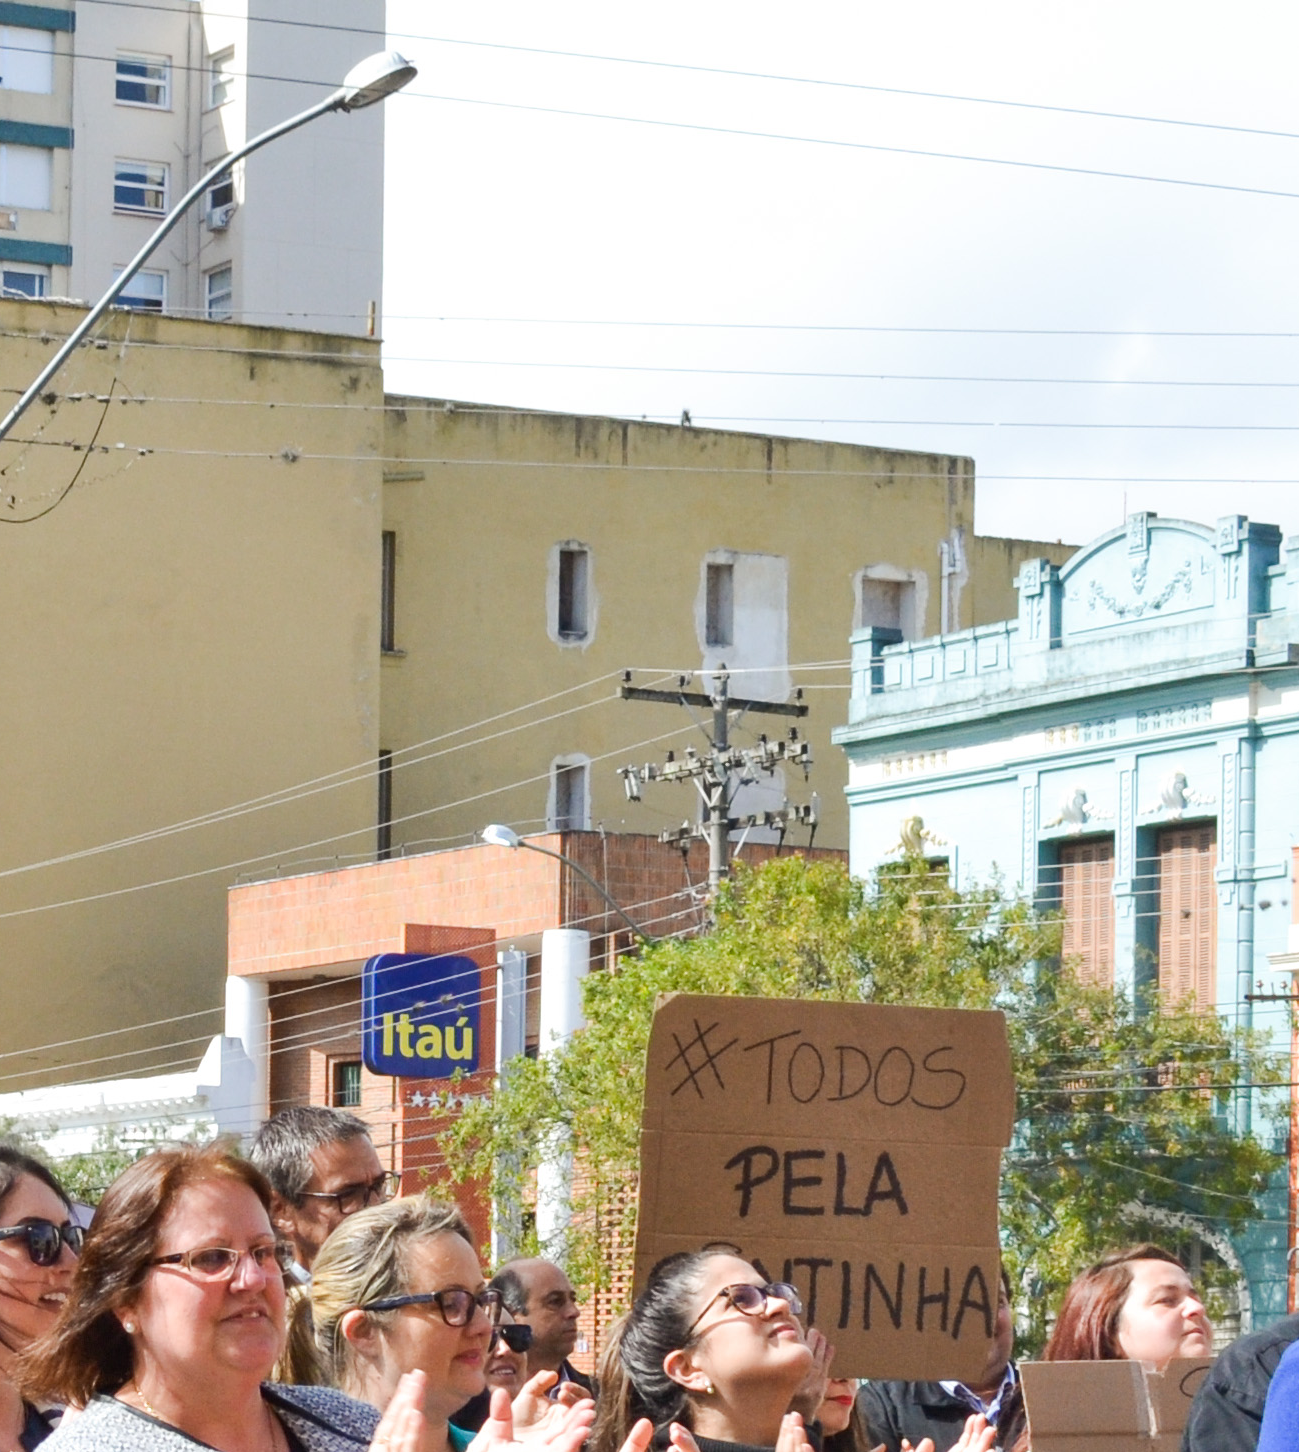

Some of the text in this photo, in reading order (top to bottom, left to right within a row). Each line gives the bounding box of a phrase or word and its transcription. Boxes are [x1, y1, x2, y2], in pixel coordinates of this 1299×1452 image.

[382, 1012, 474, 1061] Itaú
[665, 1018, 967, 1111] #TODOS
[723, 1144, 909, 1218] PELA
[702, 1241, 993, 1340] TINHA
